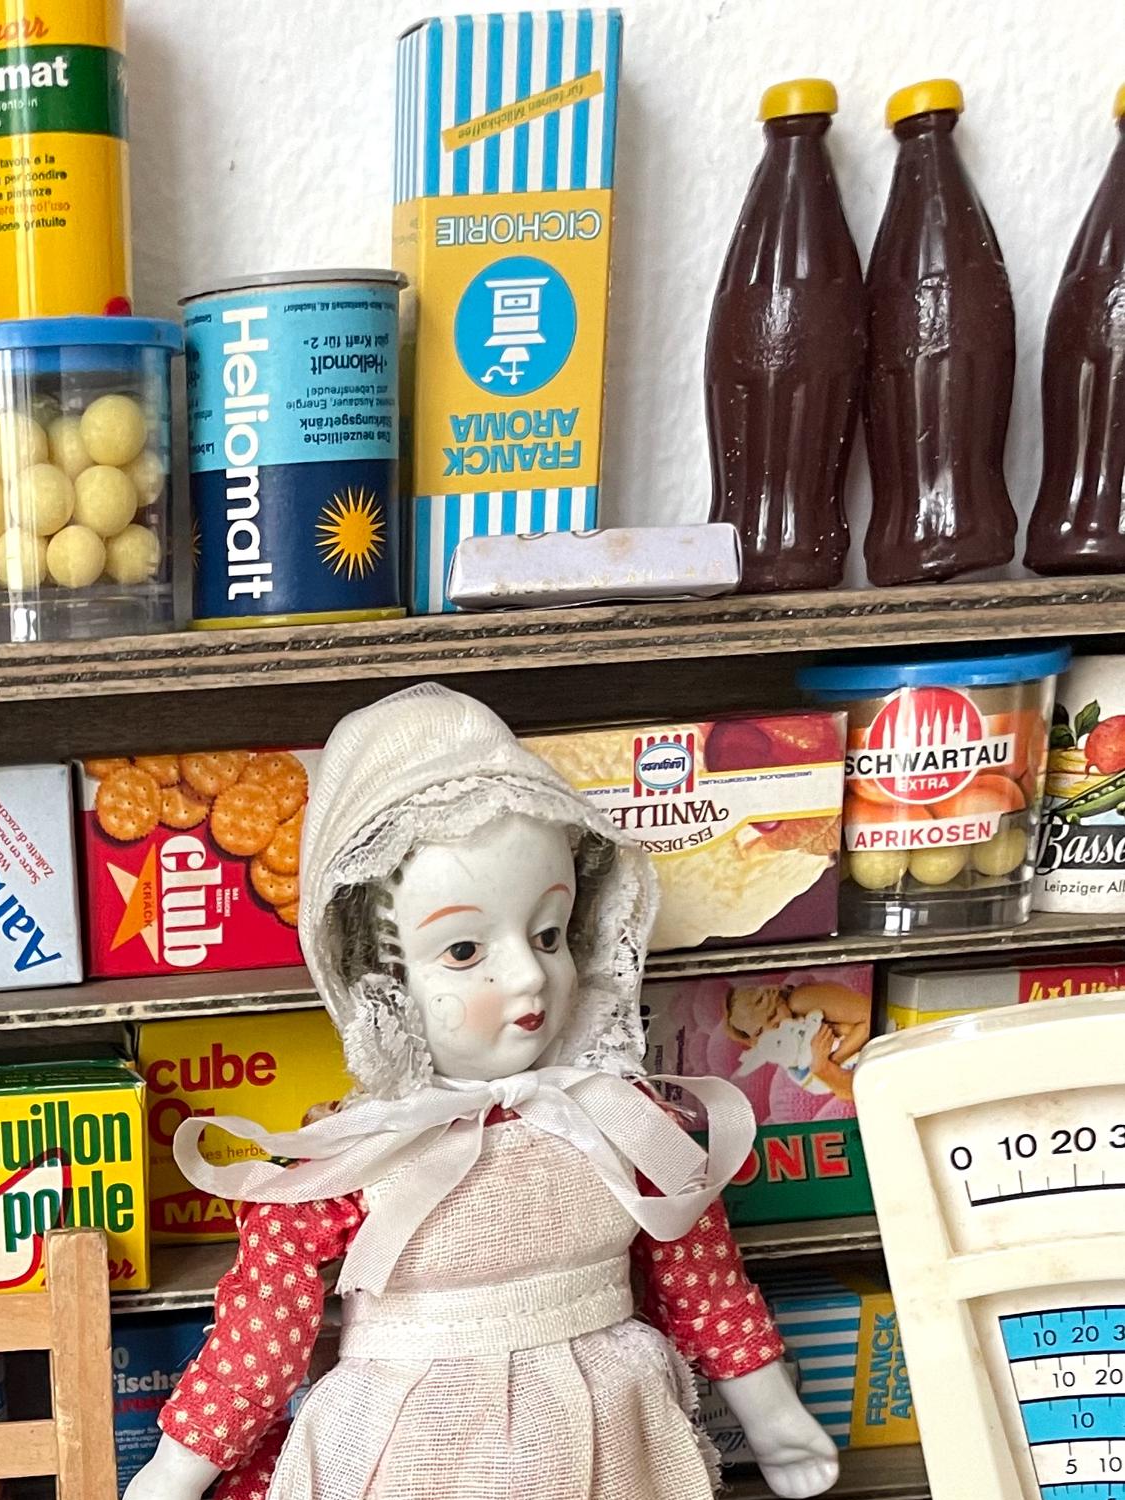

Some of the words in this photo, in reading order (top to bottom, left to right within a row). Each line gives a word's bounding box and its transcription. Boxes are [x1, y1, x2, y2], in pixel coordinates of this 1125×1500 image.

[435, 209, 601, 248] CICHORIE
[324, 335, 340, 348] für
[346, 335, 371, 347] Kraft
[286, 399, 327, 411] Energie
[304, 431, 374, 445] neuzeitliche
[450, 407, 579, 443] AROMA
[222, 306, 273, 600] Heliomalt
[442, 439, 582, 476] FRANCK
[845, 742, 1008, 777] SCHWARTAU
[898, 777, 949, 793] EXTRA
[608, 799, 729, 830] VANILLE
[854, 820, 991, 849] APRIKOSEN
[1044, 880, 1104, 896] Leipziger
[142, 881, 153, 927] KRACK
[146, 1043, 277, 1094] cube
[950, 1146, 972, 1170] 0
[998, 1134, 1037, 1160] 10
[1051, 1127, 1096, 1154] 20
[3, 1170, 134, 1253] poule
[164, 1199, 240, 1225] MA
[1033, 1330, 1057, 1347] 10
[1072, 1325, 1099, 1343] 20
[866, 1312, 897, 1426] FRANCK
[1053, 1371, 1076, 1388] 10
[1095, 1368, 1123, 1385] 20
[1072, 1412, 1094, 1429] 10
[1066, 1459, 1078, 1474] 5
[1099, 1456, 1122, 1473] 10
